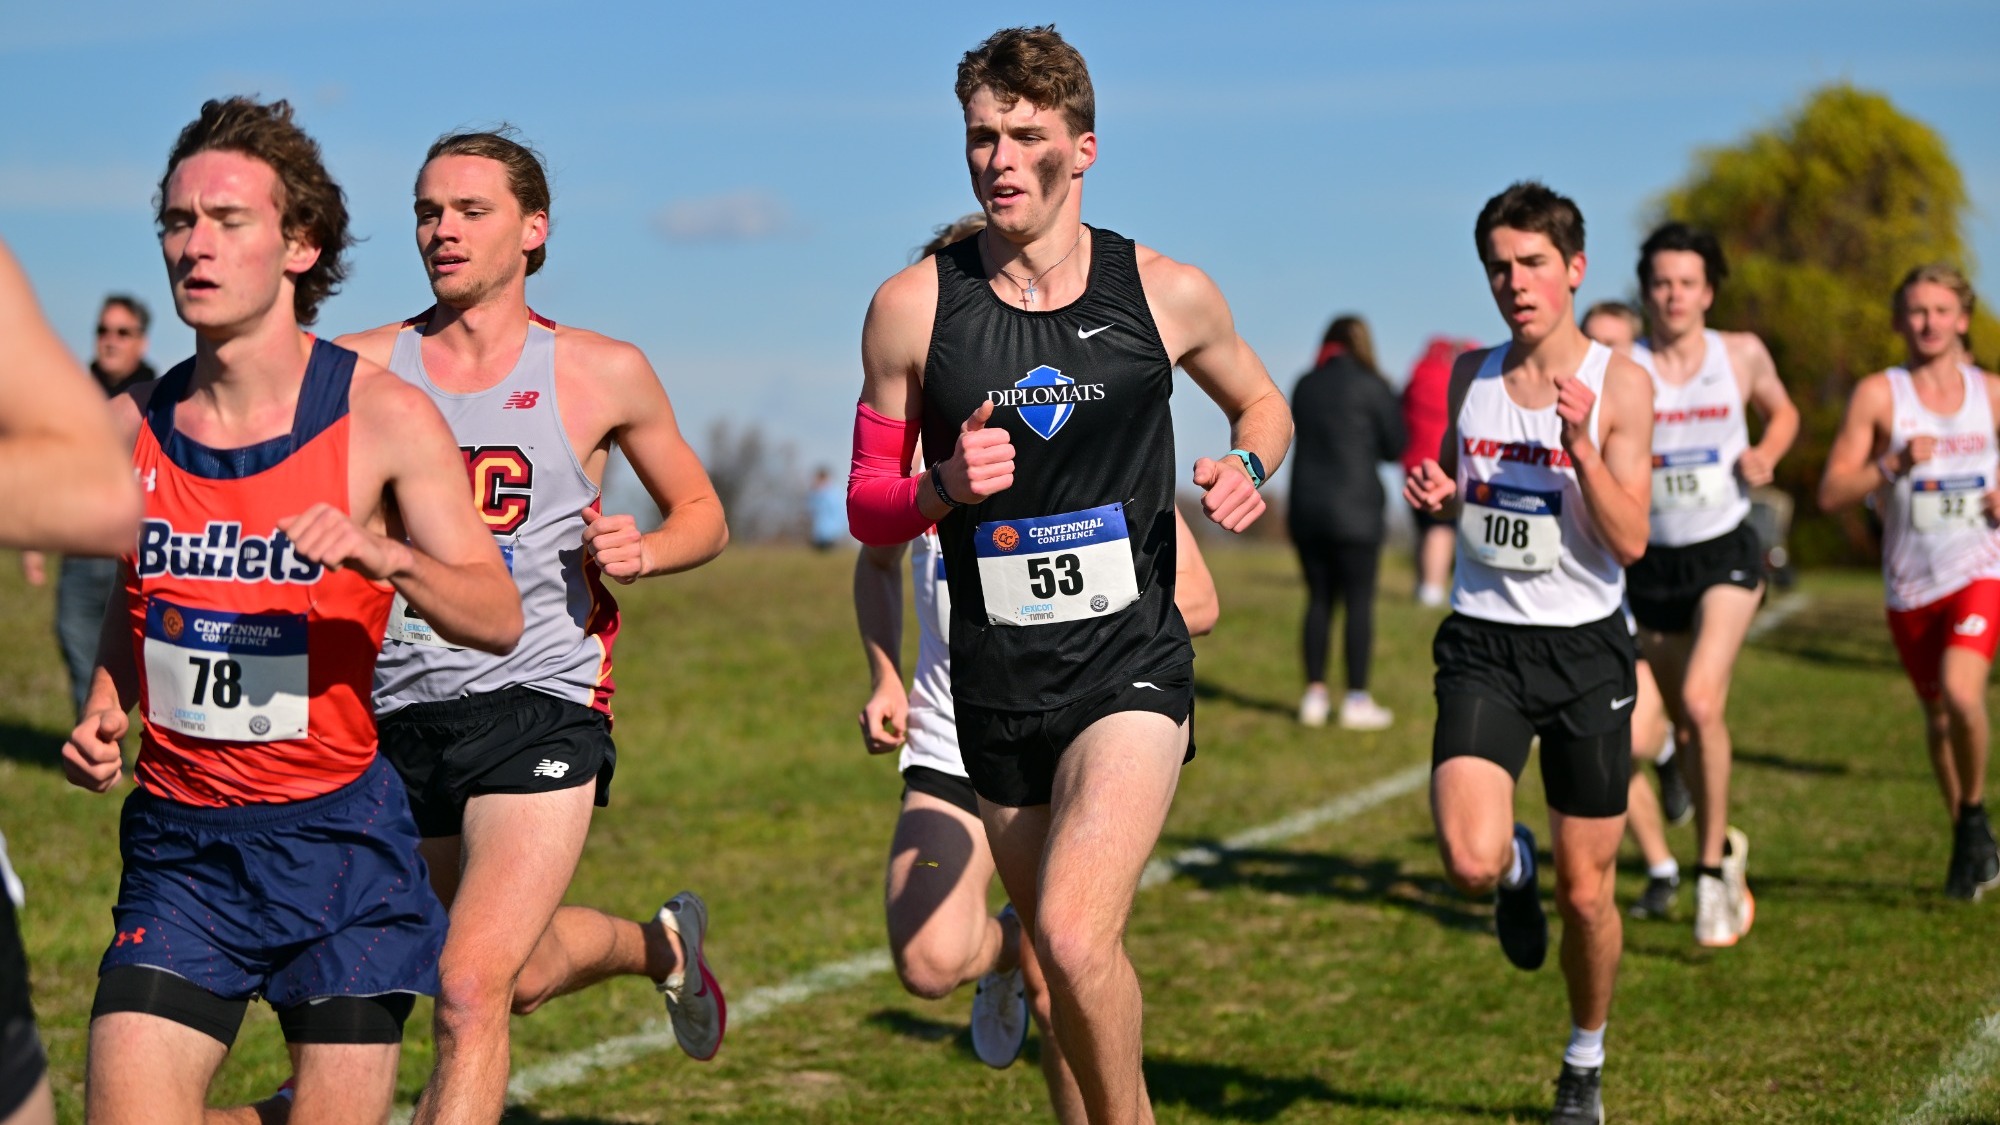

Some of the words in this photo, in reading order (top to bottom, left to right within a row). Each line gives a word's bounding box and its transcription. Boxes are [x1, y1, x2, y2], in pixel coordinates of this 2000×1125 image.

[986, 383, 1105, 407] DIPLOMATS
[460, 445, 533, 537] C
[1028, 517, 1104, 538] CENTENNIAL
[1037, 530, 1095, 545] CONFERENCE
[1484, 513, 1529, 549] 108
[137, 518, 323, 585] Bullets
[1026, 553, 1084, 600] 53
[193, 618, 281, 638] CENTENNIAL
[201, 632, 269, 647] CONFERENCE
[189, 655, 243, 709] 78
